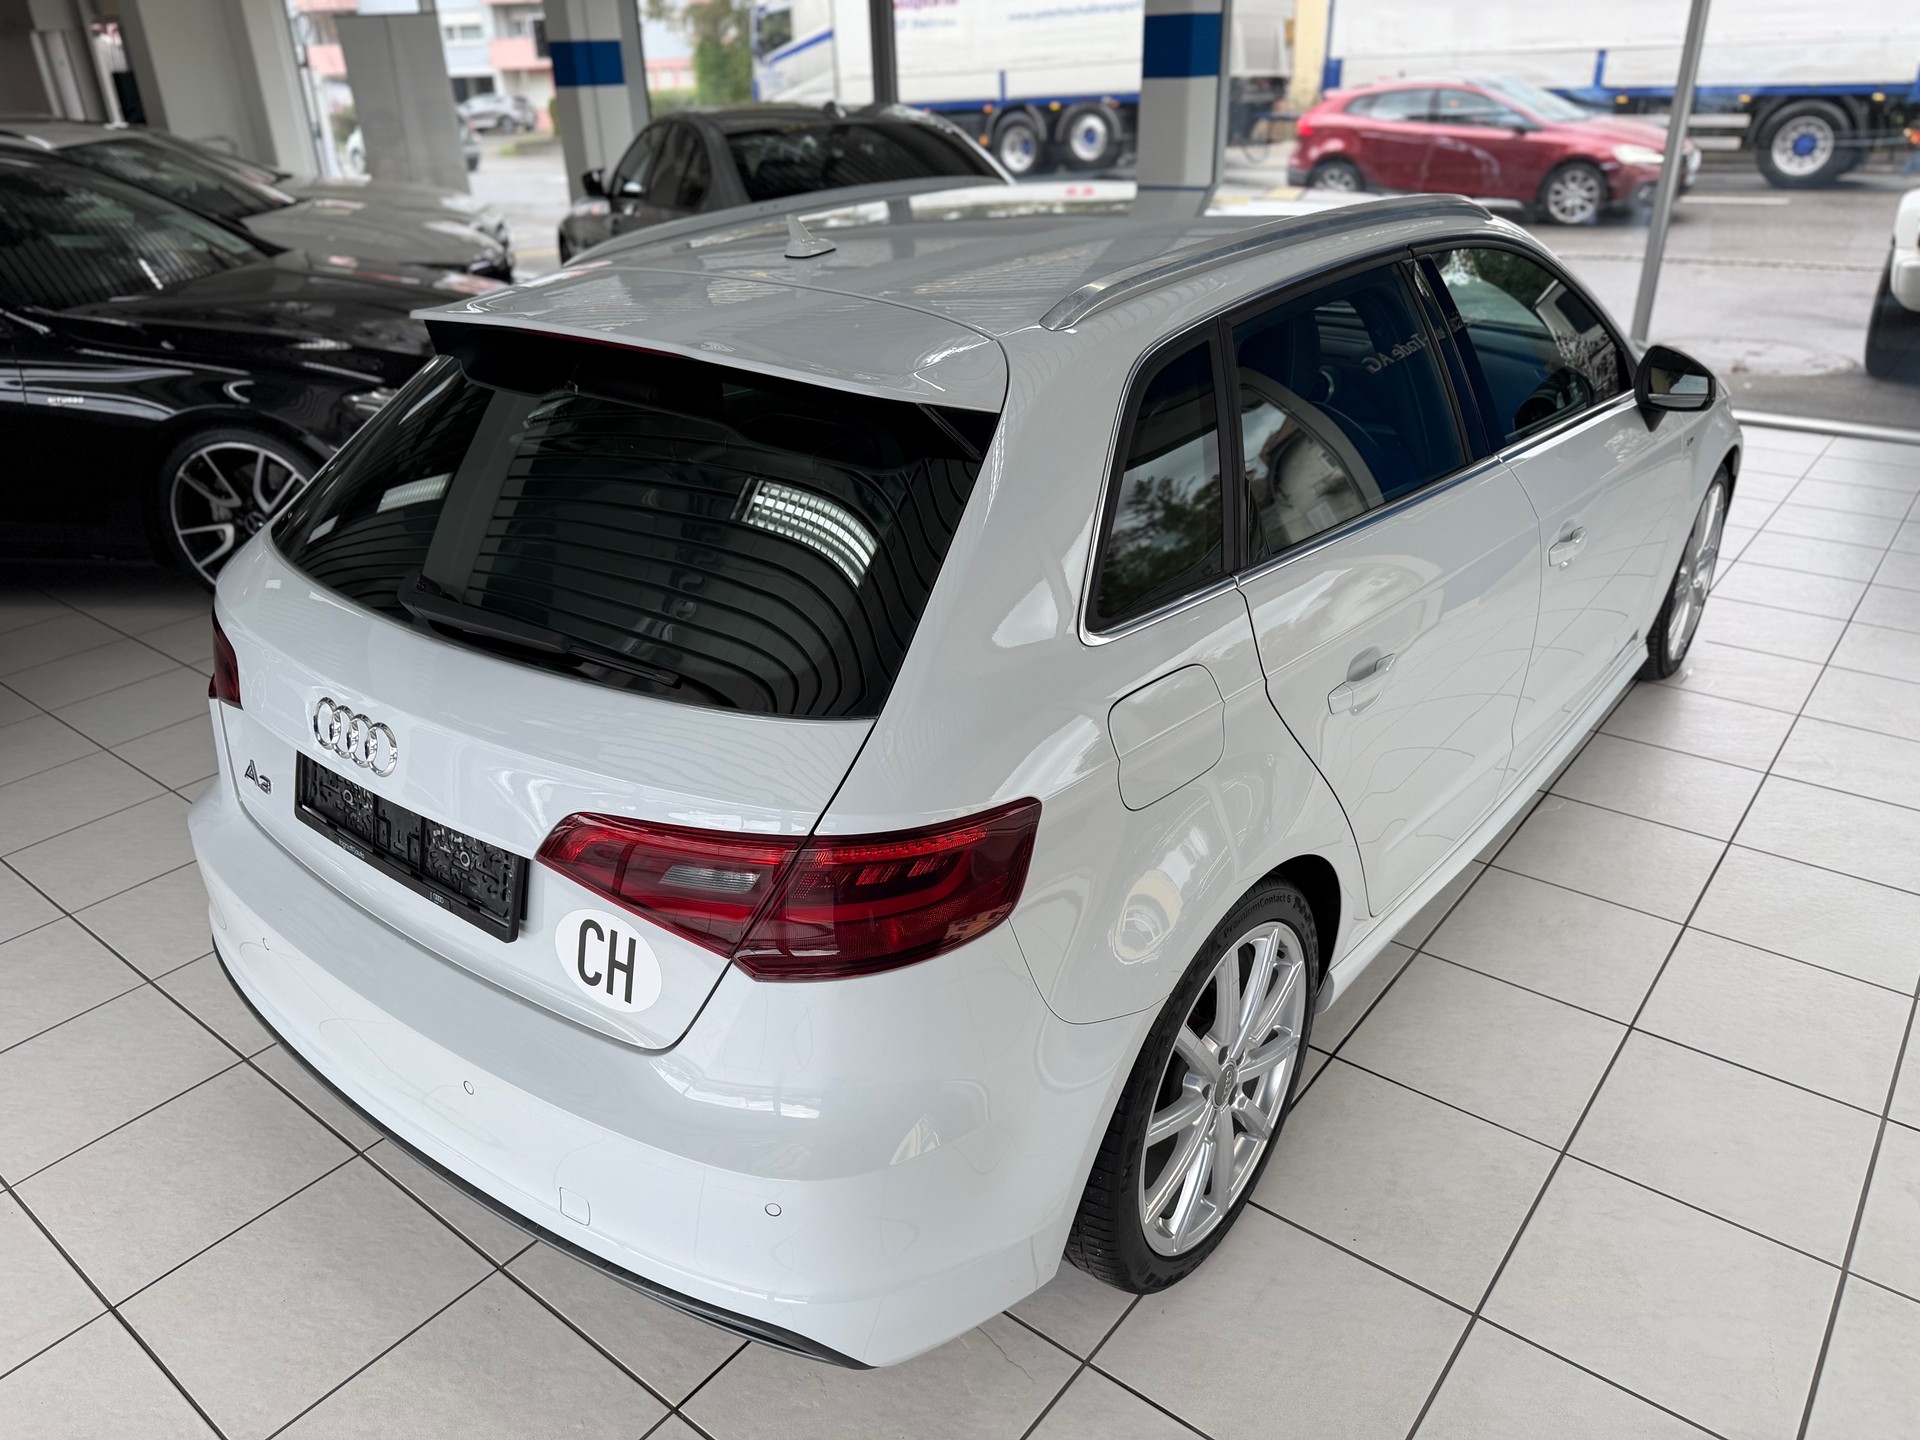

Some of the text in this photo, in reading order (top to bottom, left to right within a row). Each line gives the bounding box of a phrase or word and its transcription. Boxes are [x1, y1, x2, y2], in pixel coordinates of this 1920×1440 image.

[244, 759, 271, 795] A3
[1223, 892, 1292, 938] PremiumContact 6
[577, 918, 637, 1005] CH
